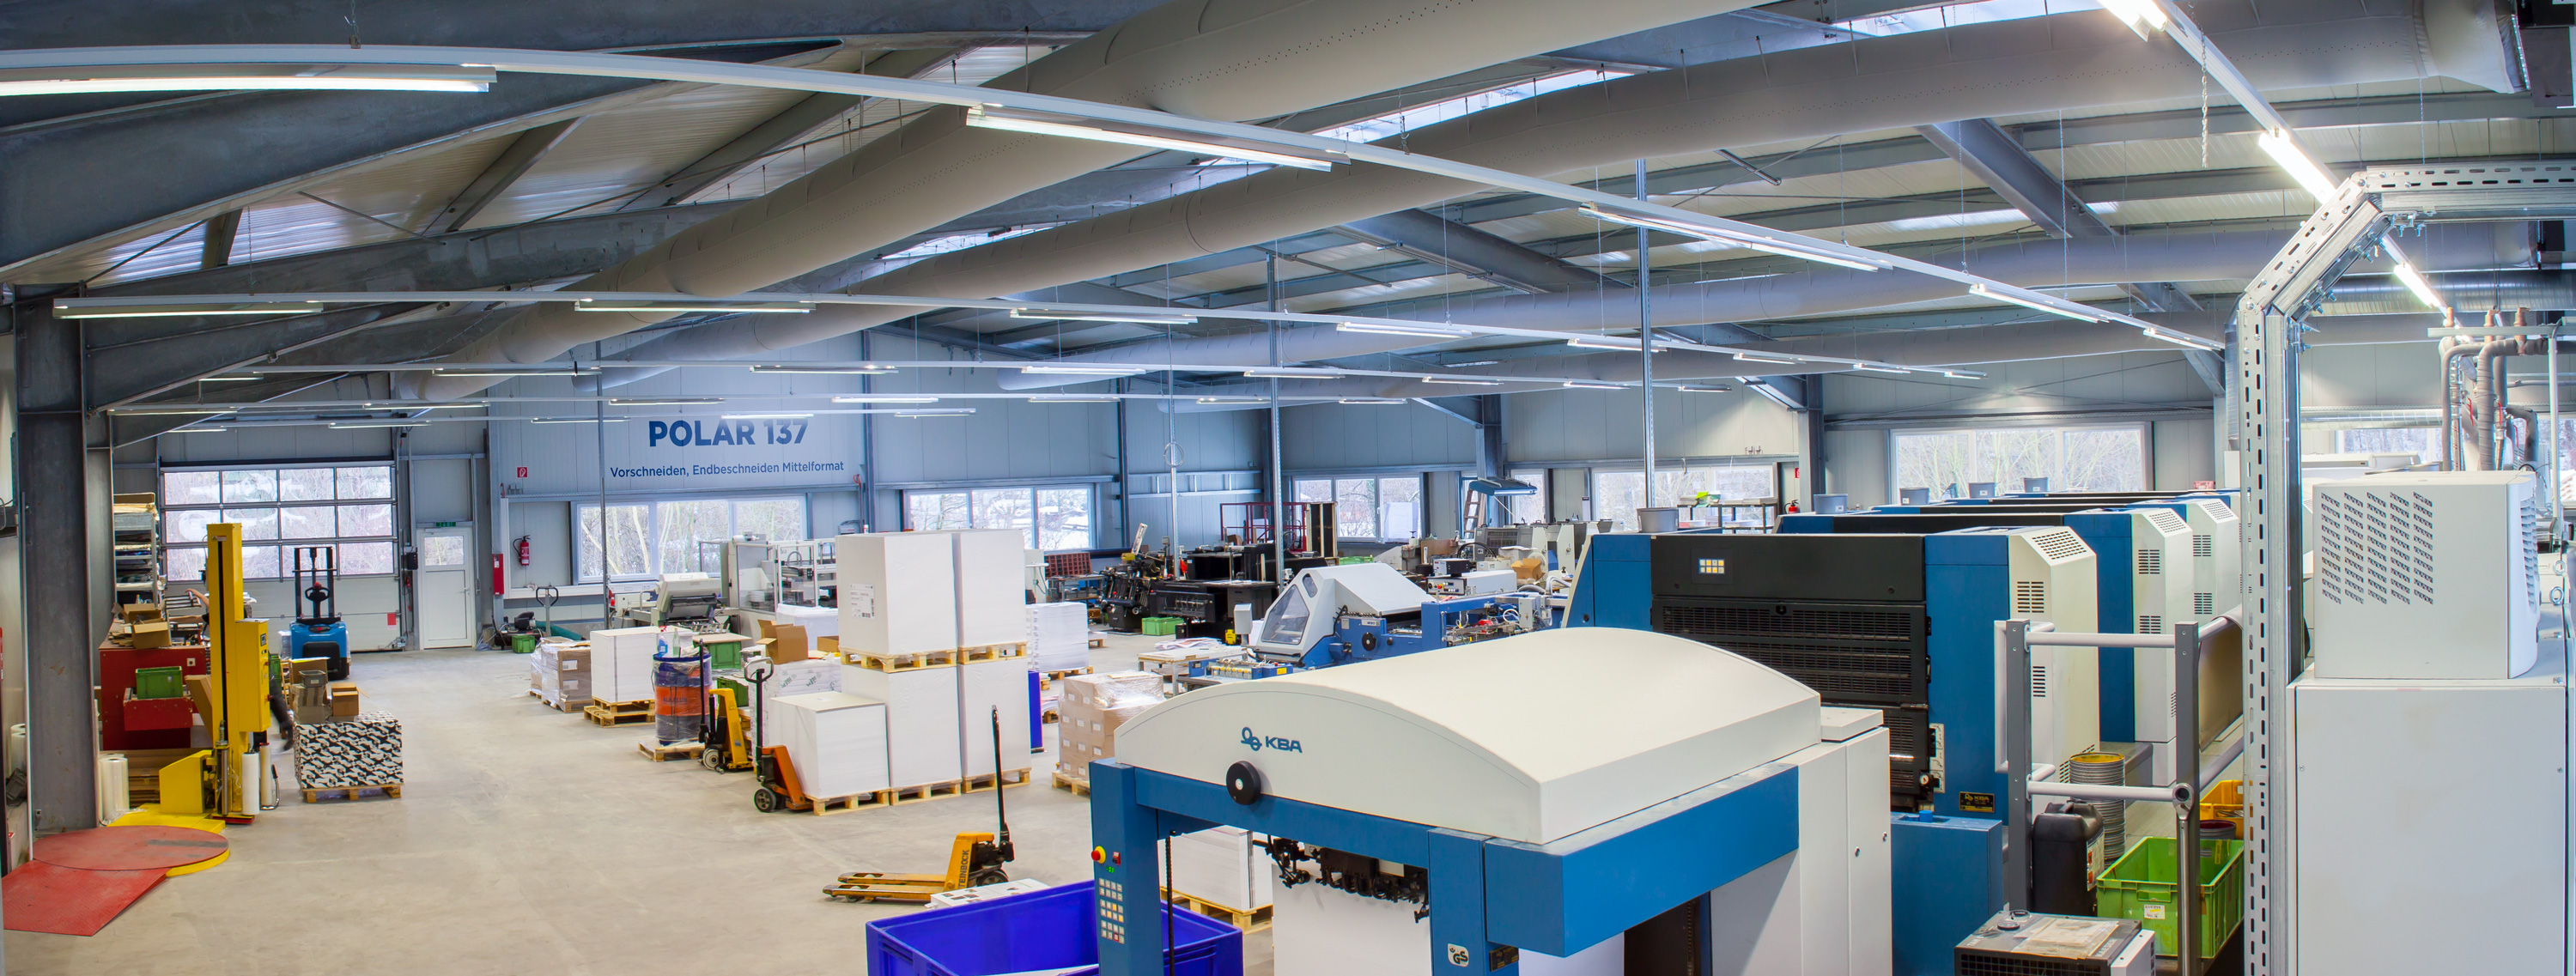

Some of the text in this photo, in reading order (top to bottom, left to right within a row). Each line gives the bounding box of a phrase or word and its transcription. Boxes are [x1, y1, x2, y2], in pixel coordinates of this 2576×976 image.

[648, 419, 809, 447] POLAR 137
[611, 461, 844, 477] Vorschneiden, Endbeschneiden Mittelformat
[1265, 736, 1303, 754] KBA
[958, 850, 970, 888] TEINBOCK
